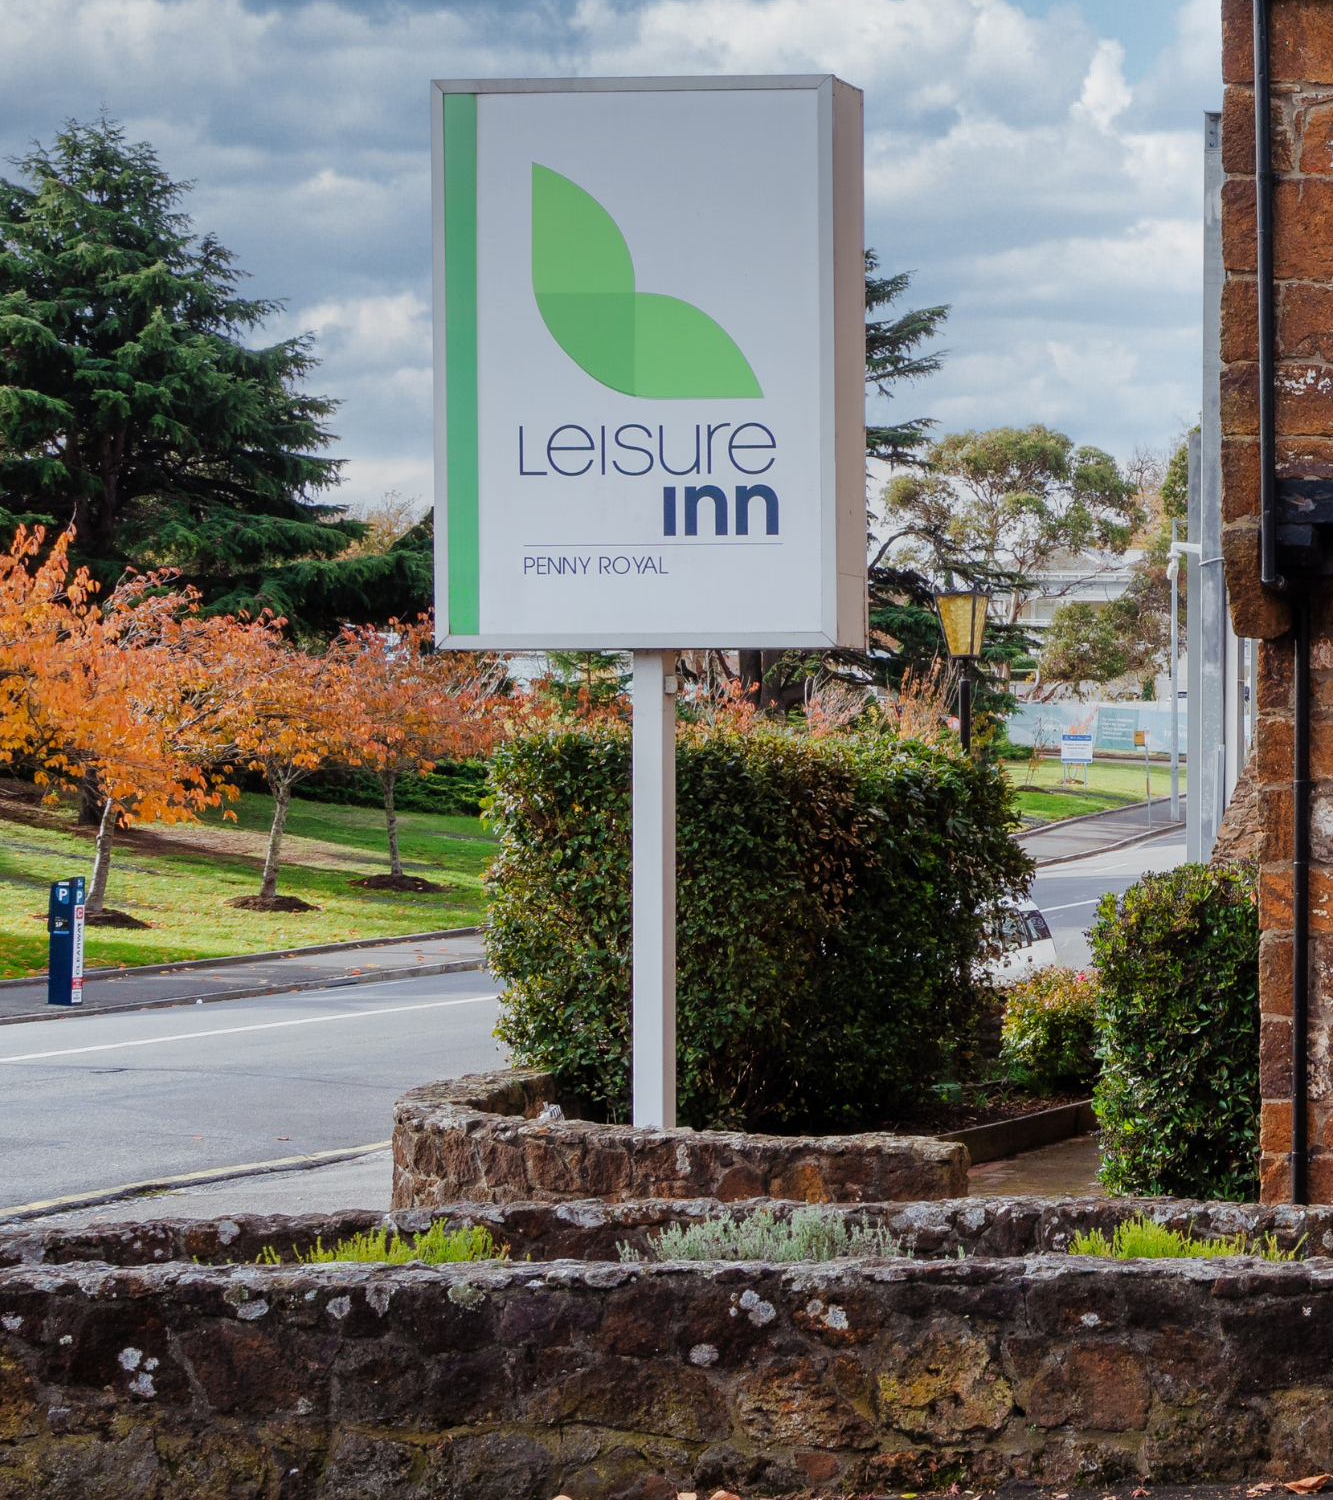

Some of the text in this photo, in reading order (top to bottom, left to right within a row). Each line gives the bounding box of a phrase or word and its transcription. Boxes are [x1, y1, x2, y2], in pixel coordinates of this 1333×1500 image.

[523, 555, 670, 575] PENNY ROYAL
[59, 888, 68, 901] P
[77, 890, 83, 904] P
